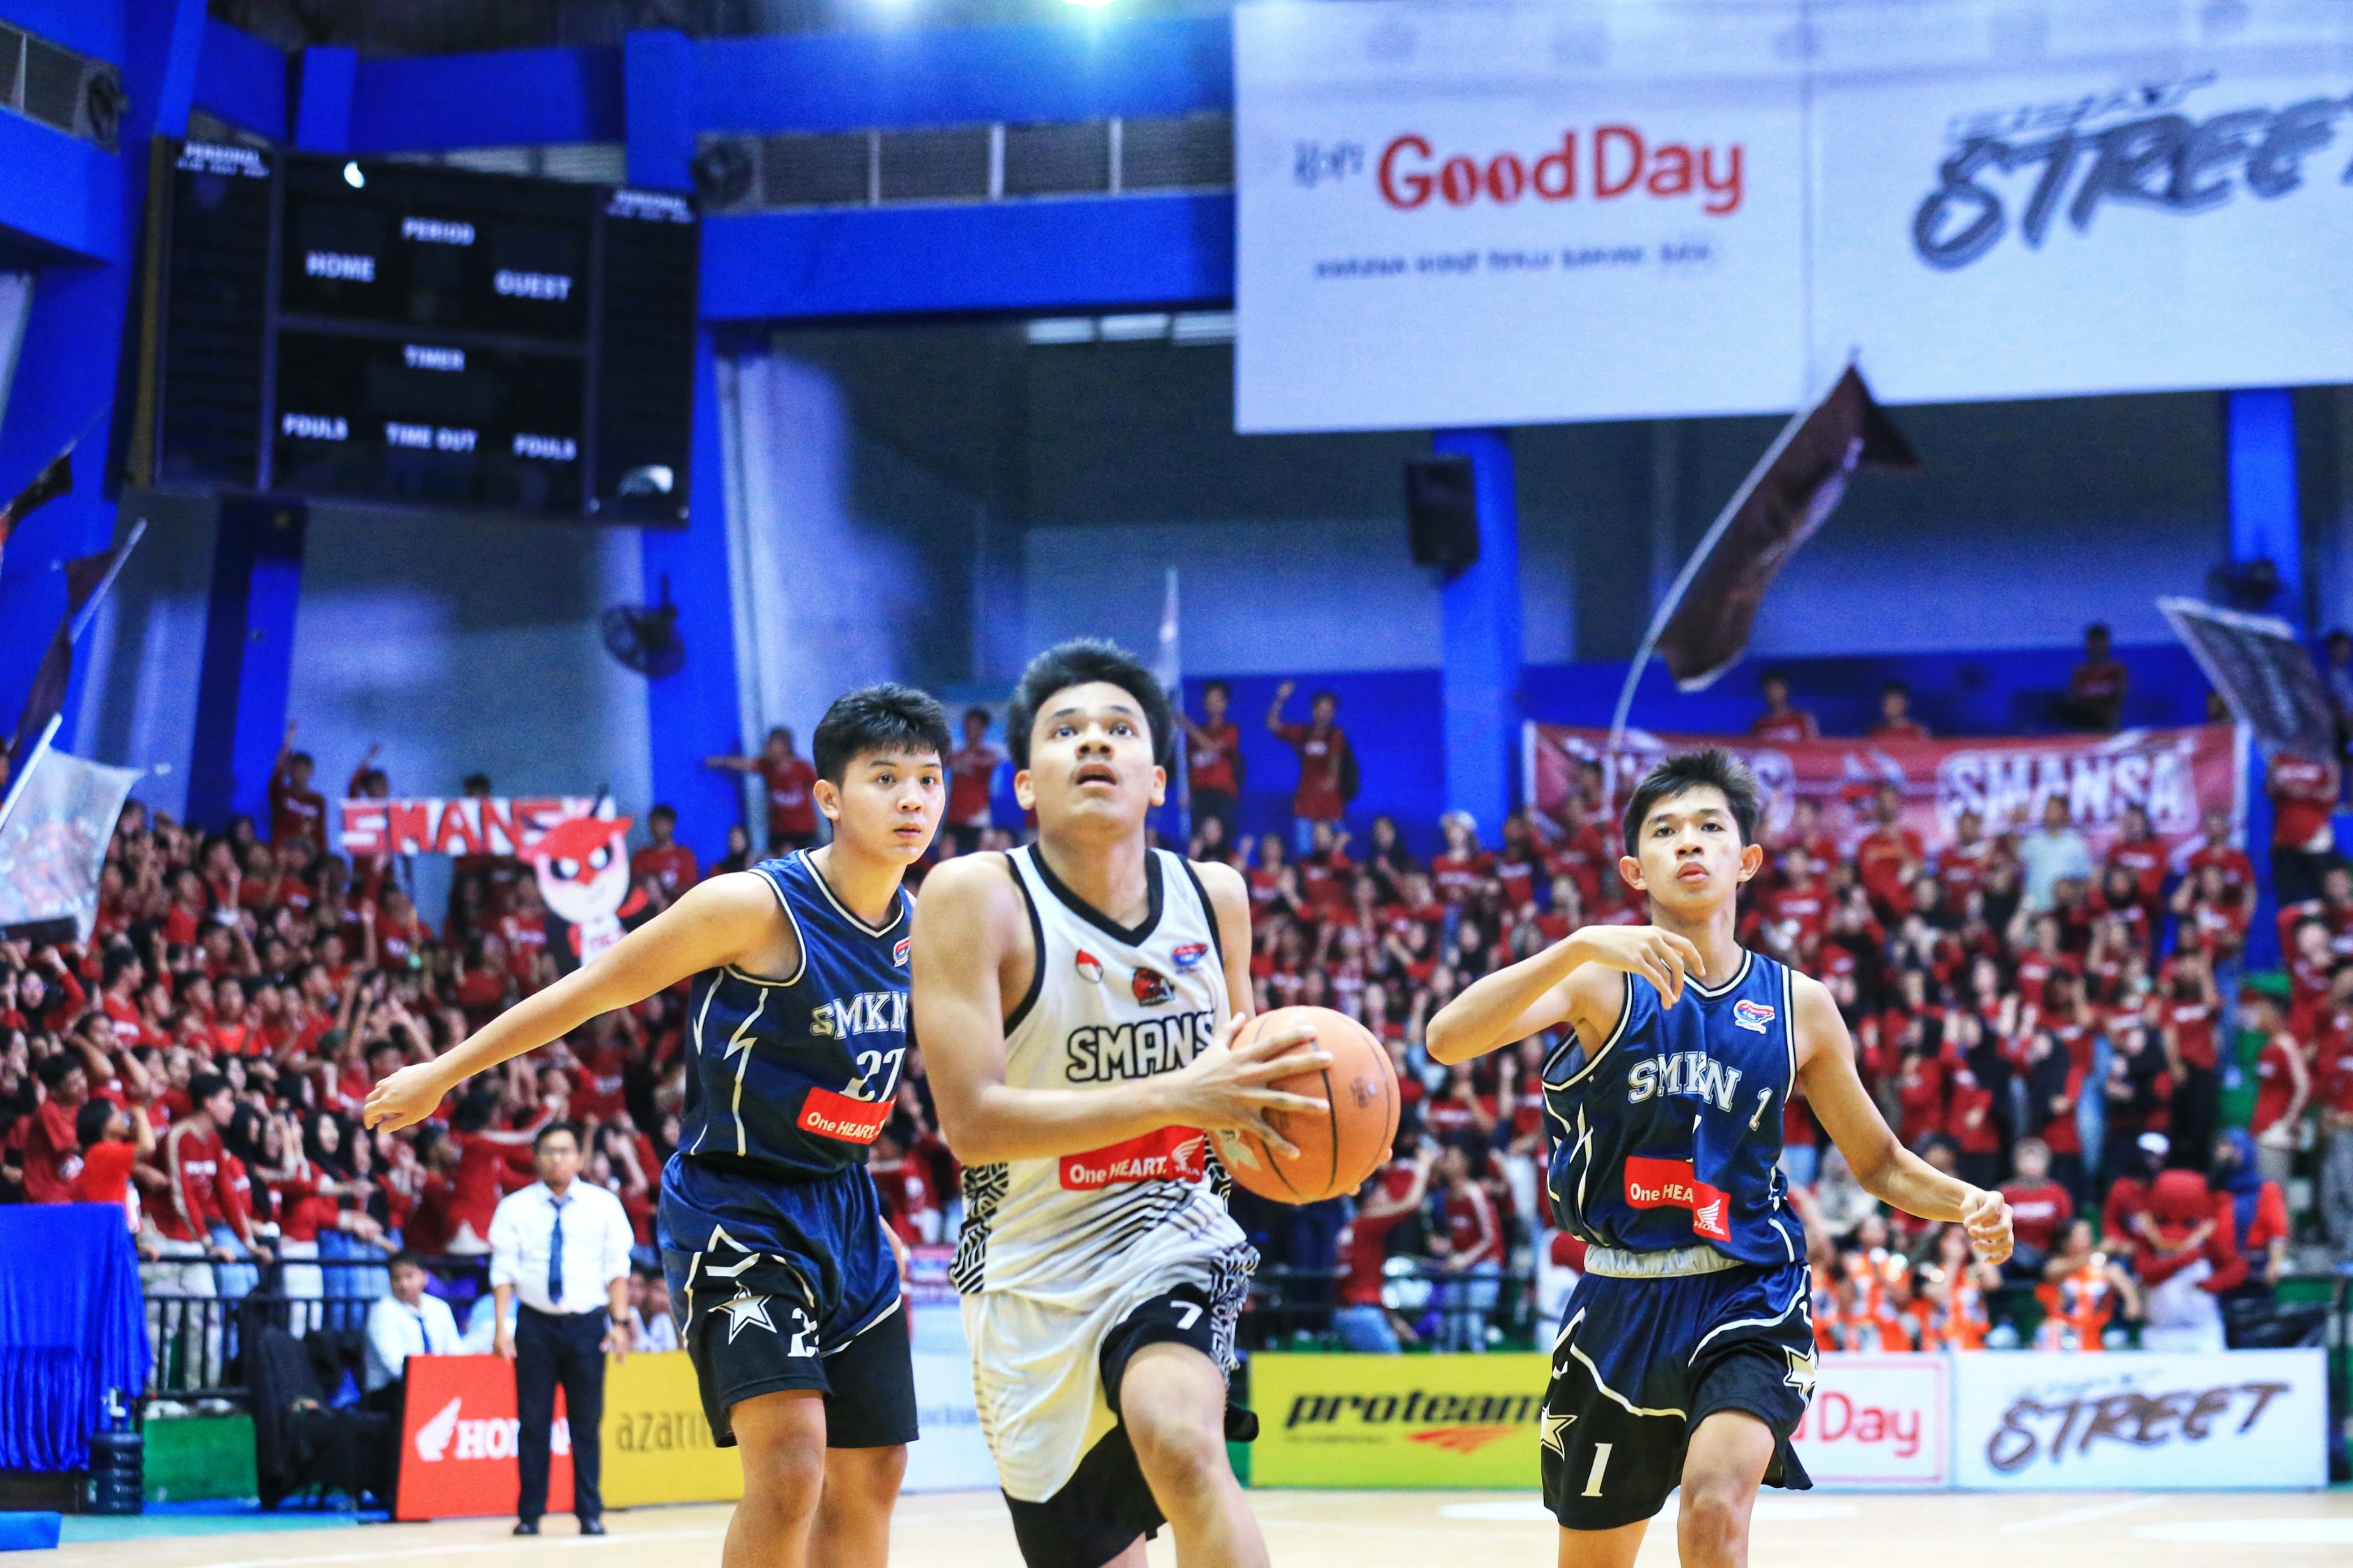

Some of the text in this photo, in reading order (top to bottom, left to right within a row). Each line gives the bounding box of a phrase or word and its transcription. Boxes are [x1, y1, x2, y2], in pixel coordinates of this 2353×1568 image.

[401, 217, 476, 246] PERIOD
[305, 252, 376, 282] HOME
[493, 272, 572, 301] GUEST
[403, 343, 466, 372] TIMER
[282, 413, 349, 440] FOULS
[385, 422, 478, 453] TIME OUT
[512, 434, 577, 460] FOULS
[809, 991, 909, 1040] SMKN
[838, 1047, 907, 1104] 27
[1627, 1051, 1743, 1107] SMKN
[807, 1111, 836, 1132] One
[1070, 1163, 1106, 1184] One
[1630, 1182, 1660, 1201] One
[1170, 1300, 1204, 1330] 7
[787, 1307, 819, 1358] 2
[1819, 1392, 1921, 1458] Day
[1984, 1381, 2291, 1473] STREET
[1581, 1442, 1614, 1497] 1
